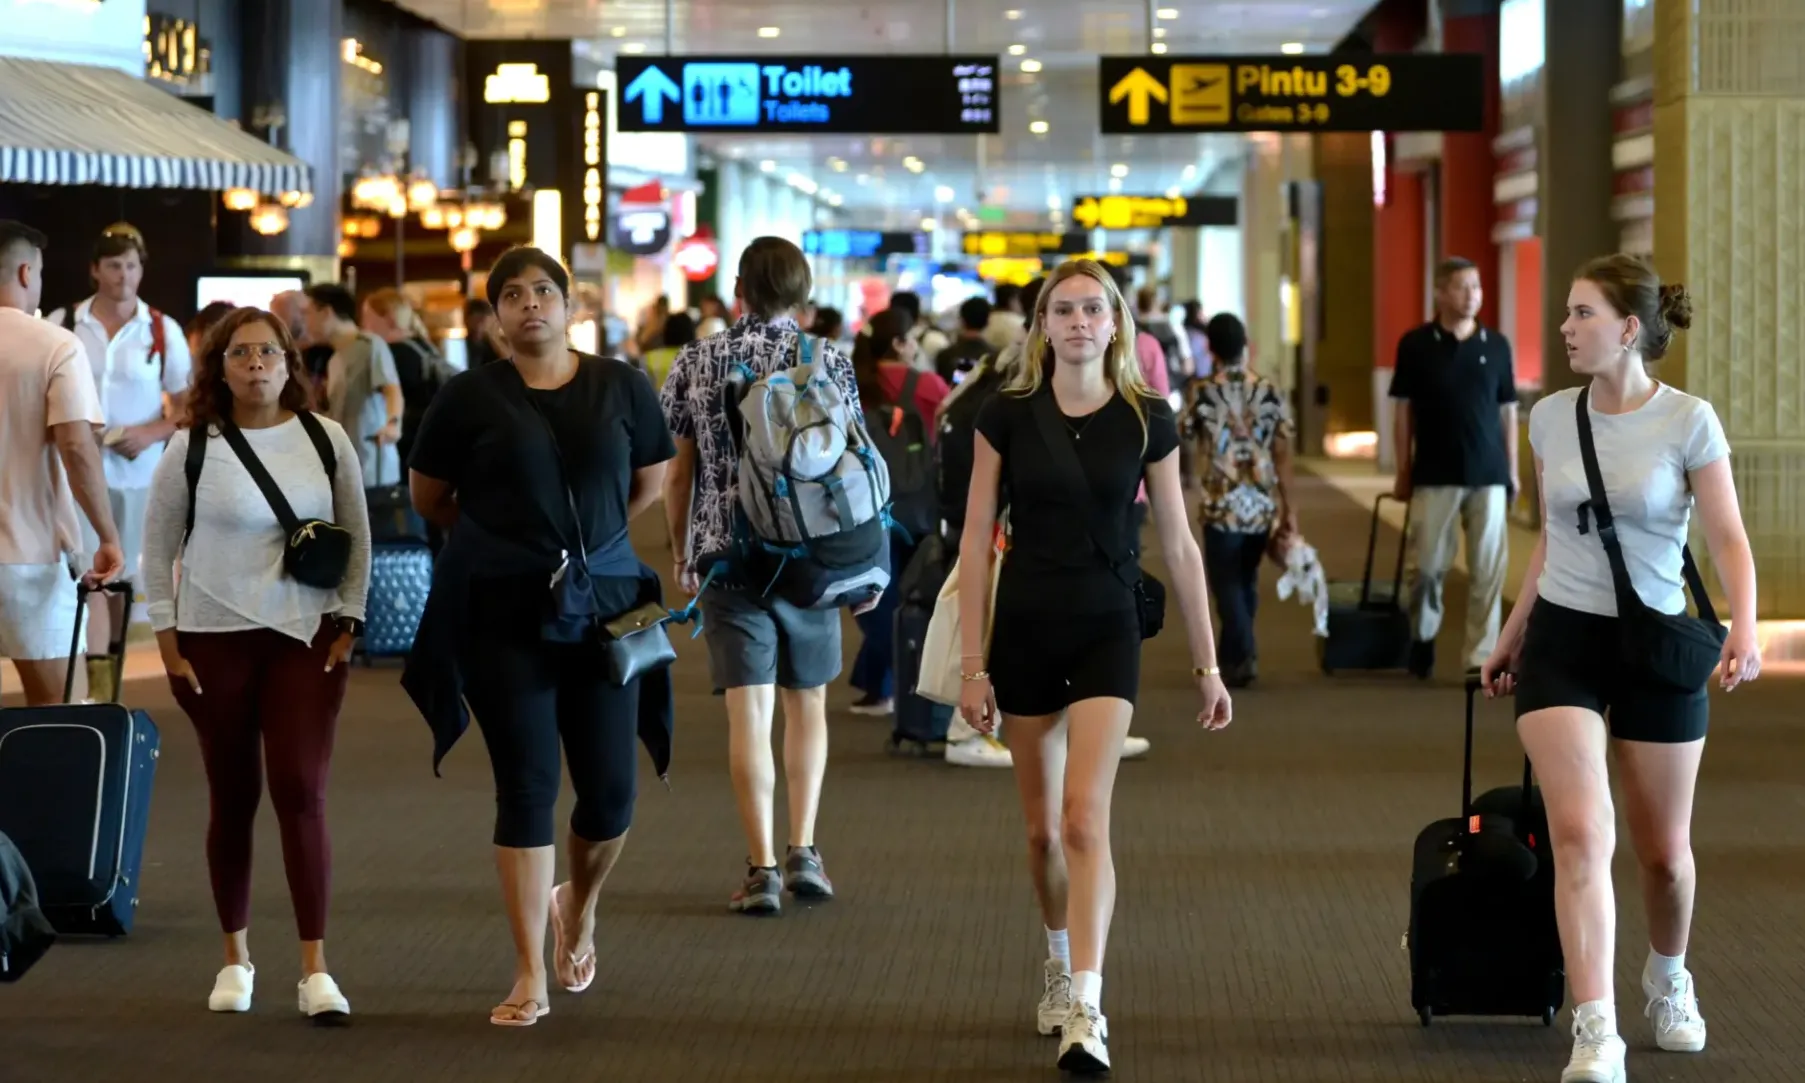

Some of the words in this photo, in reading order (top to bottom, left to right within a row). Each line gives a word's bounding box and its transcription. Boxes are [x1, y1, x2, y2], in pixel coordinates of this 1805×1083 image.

[763, 65, 852, 97] Toilet
[1237, 65, 1327, 96] Pintu
[1335, 64, 1391, 97] 3-9
[763, 100, 830, 122] Toilets
